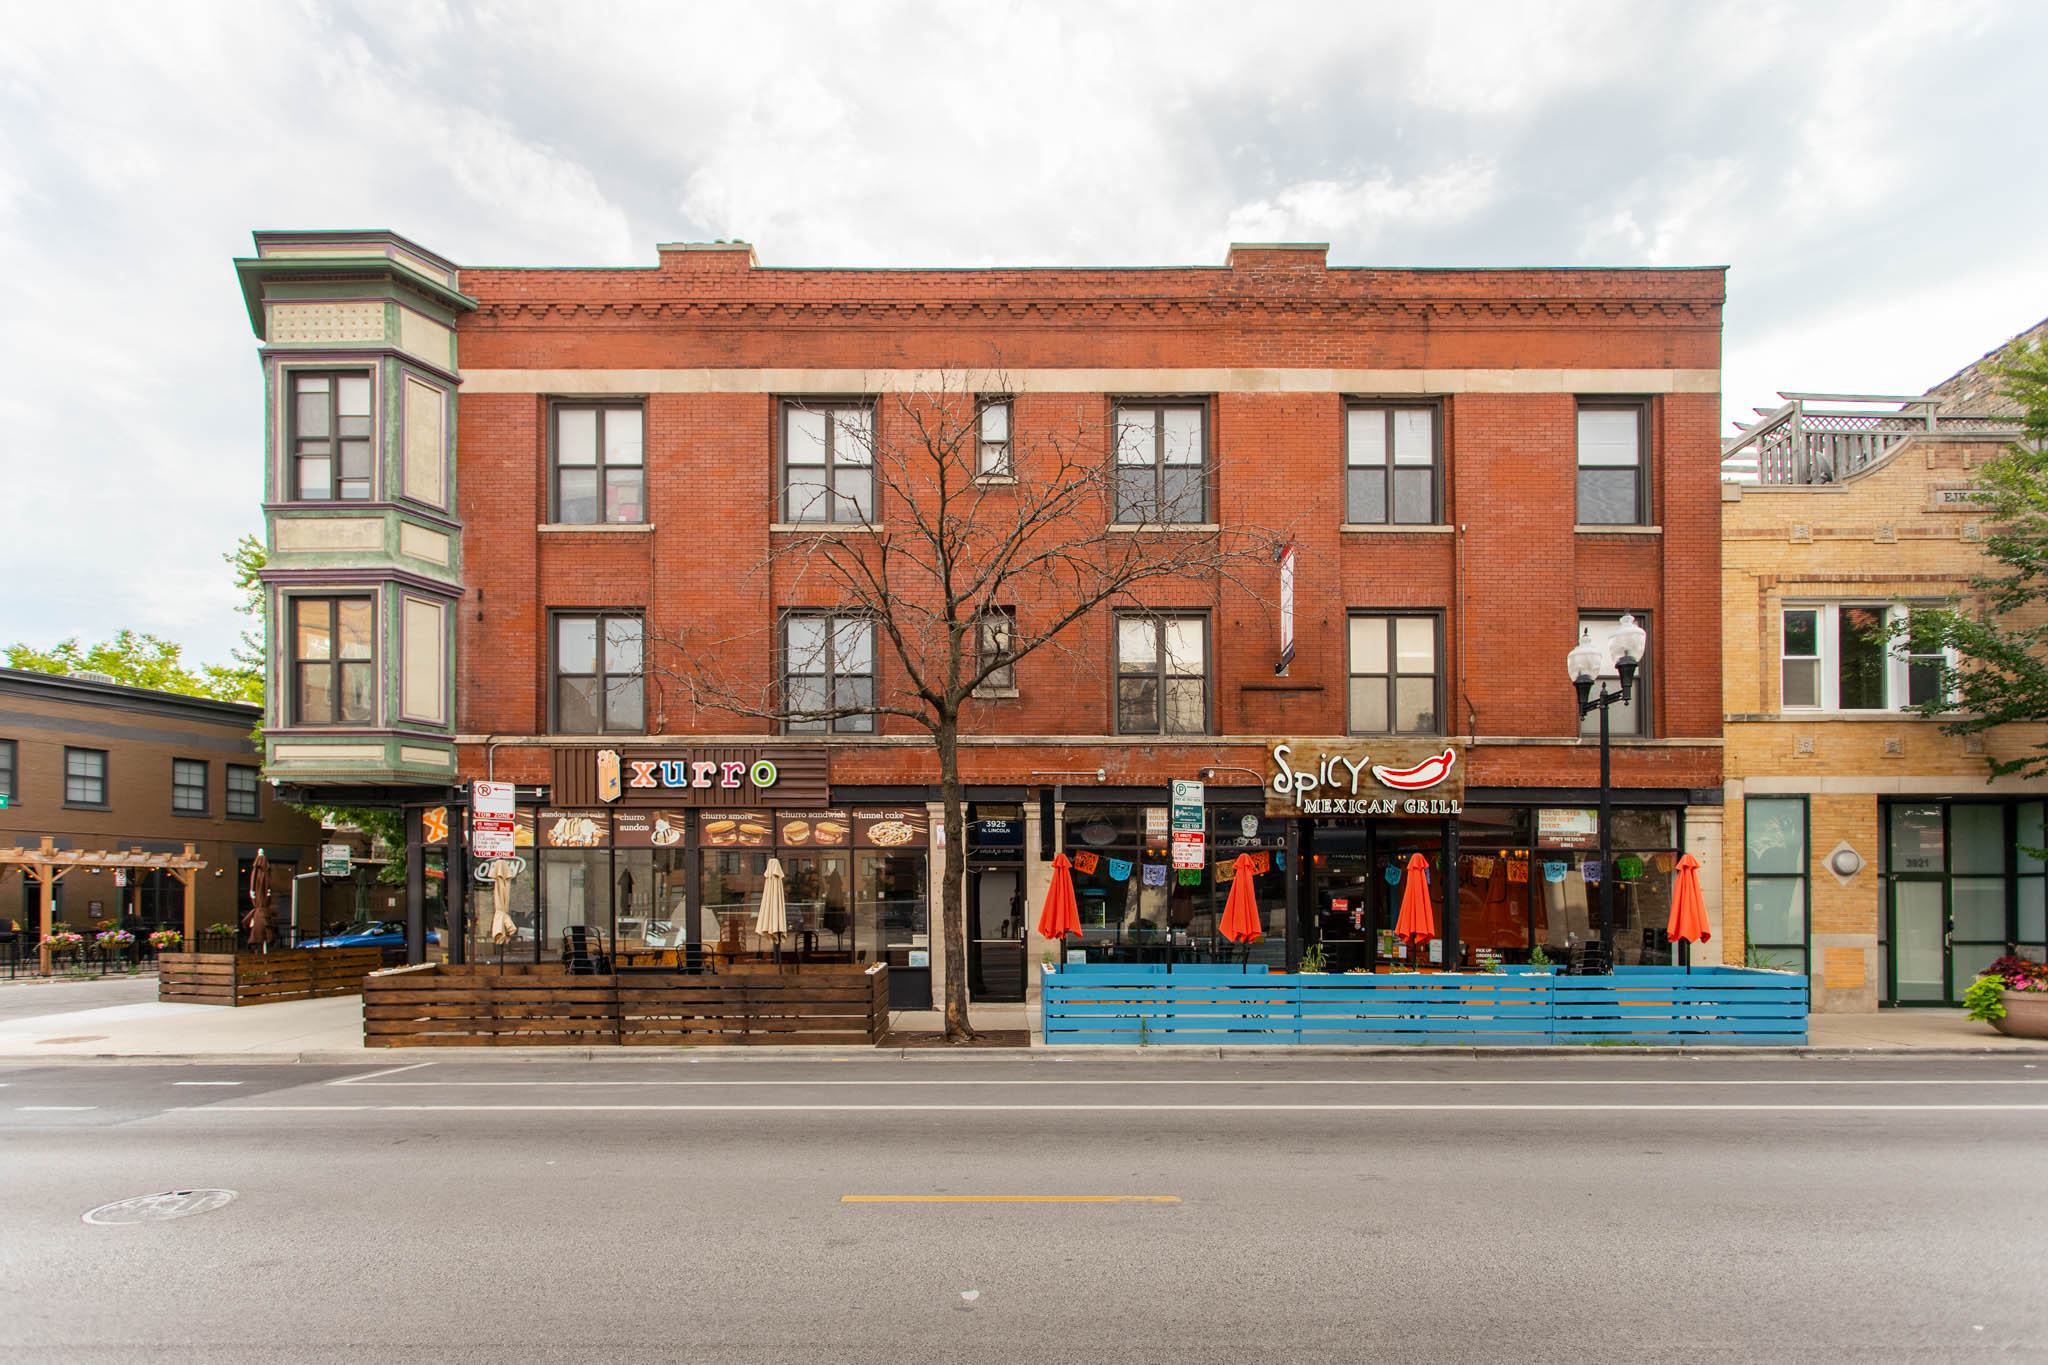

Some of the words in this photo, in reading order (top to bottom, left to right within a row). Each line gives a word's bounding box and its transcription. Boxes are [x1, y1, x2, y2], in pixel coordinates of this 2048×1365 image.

[630, 759, 777, 788] xurro
[1303, 798, 1397, 814] MEXICAN
[1403, 798, 1462, 814] GRILL
[619, 813, 646, 821] churro
[700, 811, 727, 820] churro
[728, 812, 753, 820] smore
[780, 810, 807, 819] churro
[808, 810, 847, 819] sandwich
[858, 810, 884, 820] funnel
[884, 811, 905, 820] cake
[619, 823, 650, 832] sundae
[985, 820, 1007, 828] 3925
[1905, 858, 1929, 868] 3921
[477, 860, 520, 877] OPN
